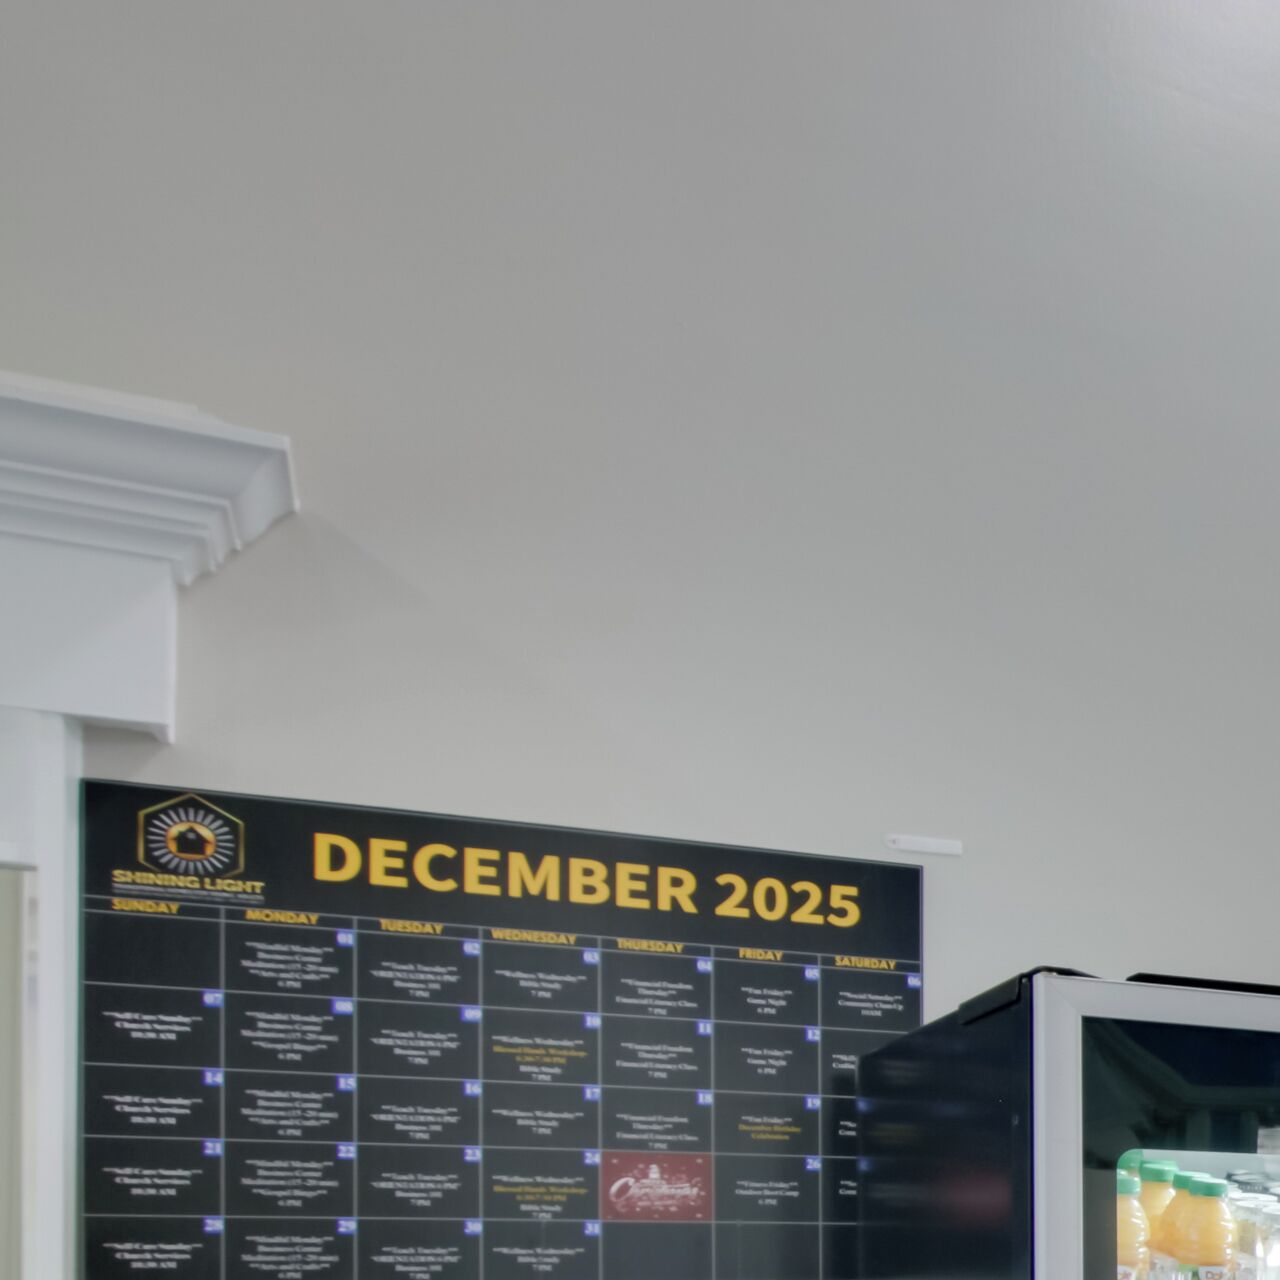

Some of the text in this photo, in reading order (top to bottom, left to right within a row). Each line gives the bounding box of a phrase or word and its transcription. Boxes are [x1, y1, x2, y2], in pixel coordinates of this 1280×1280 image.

[112, 869, 200, 889] SHINING
[204, 876, 265, 894] LIGHT
[313, 832, 861, 928] DECEMBER 2025
[111, 898, 180, 914] SUNDAY
[246, 909, 319, 925] MONDAY
[379, 918, 444, 935] TUESDAY
[491, 928, 577, 945] WEDNESDAY
[616, 937, 684, 954] THURSDAY
[739, 947, 784, 962] FRIDAY
[835, 955, 897, 970] SATURDAY
[805, 968, 819, 979] 05
[698, 1022, 712, 1034] 11
[807, 1029, 820, 1041] 12
[204, 1071, 223, 1085] 14
[338, 1076, 356, 1090] 15
[465, 1082, 481, 1095] 16
[585, 1087, 600, 1100] 17
[806, 1097, 820, 1109] 19
